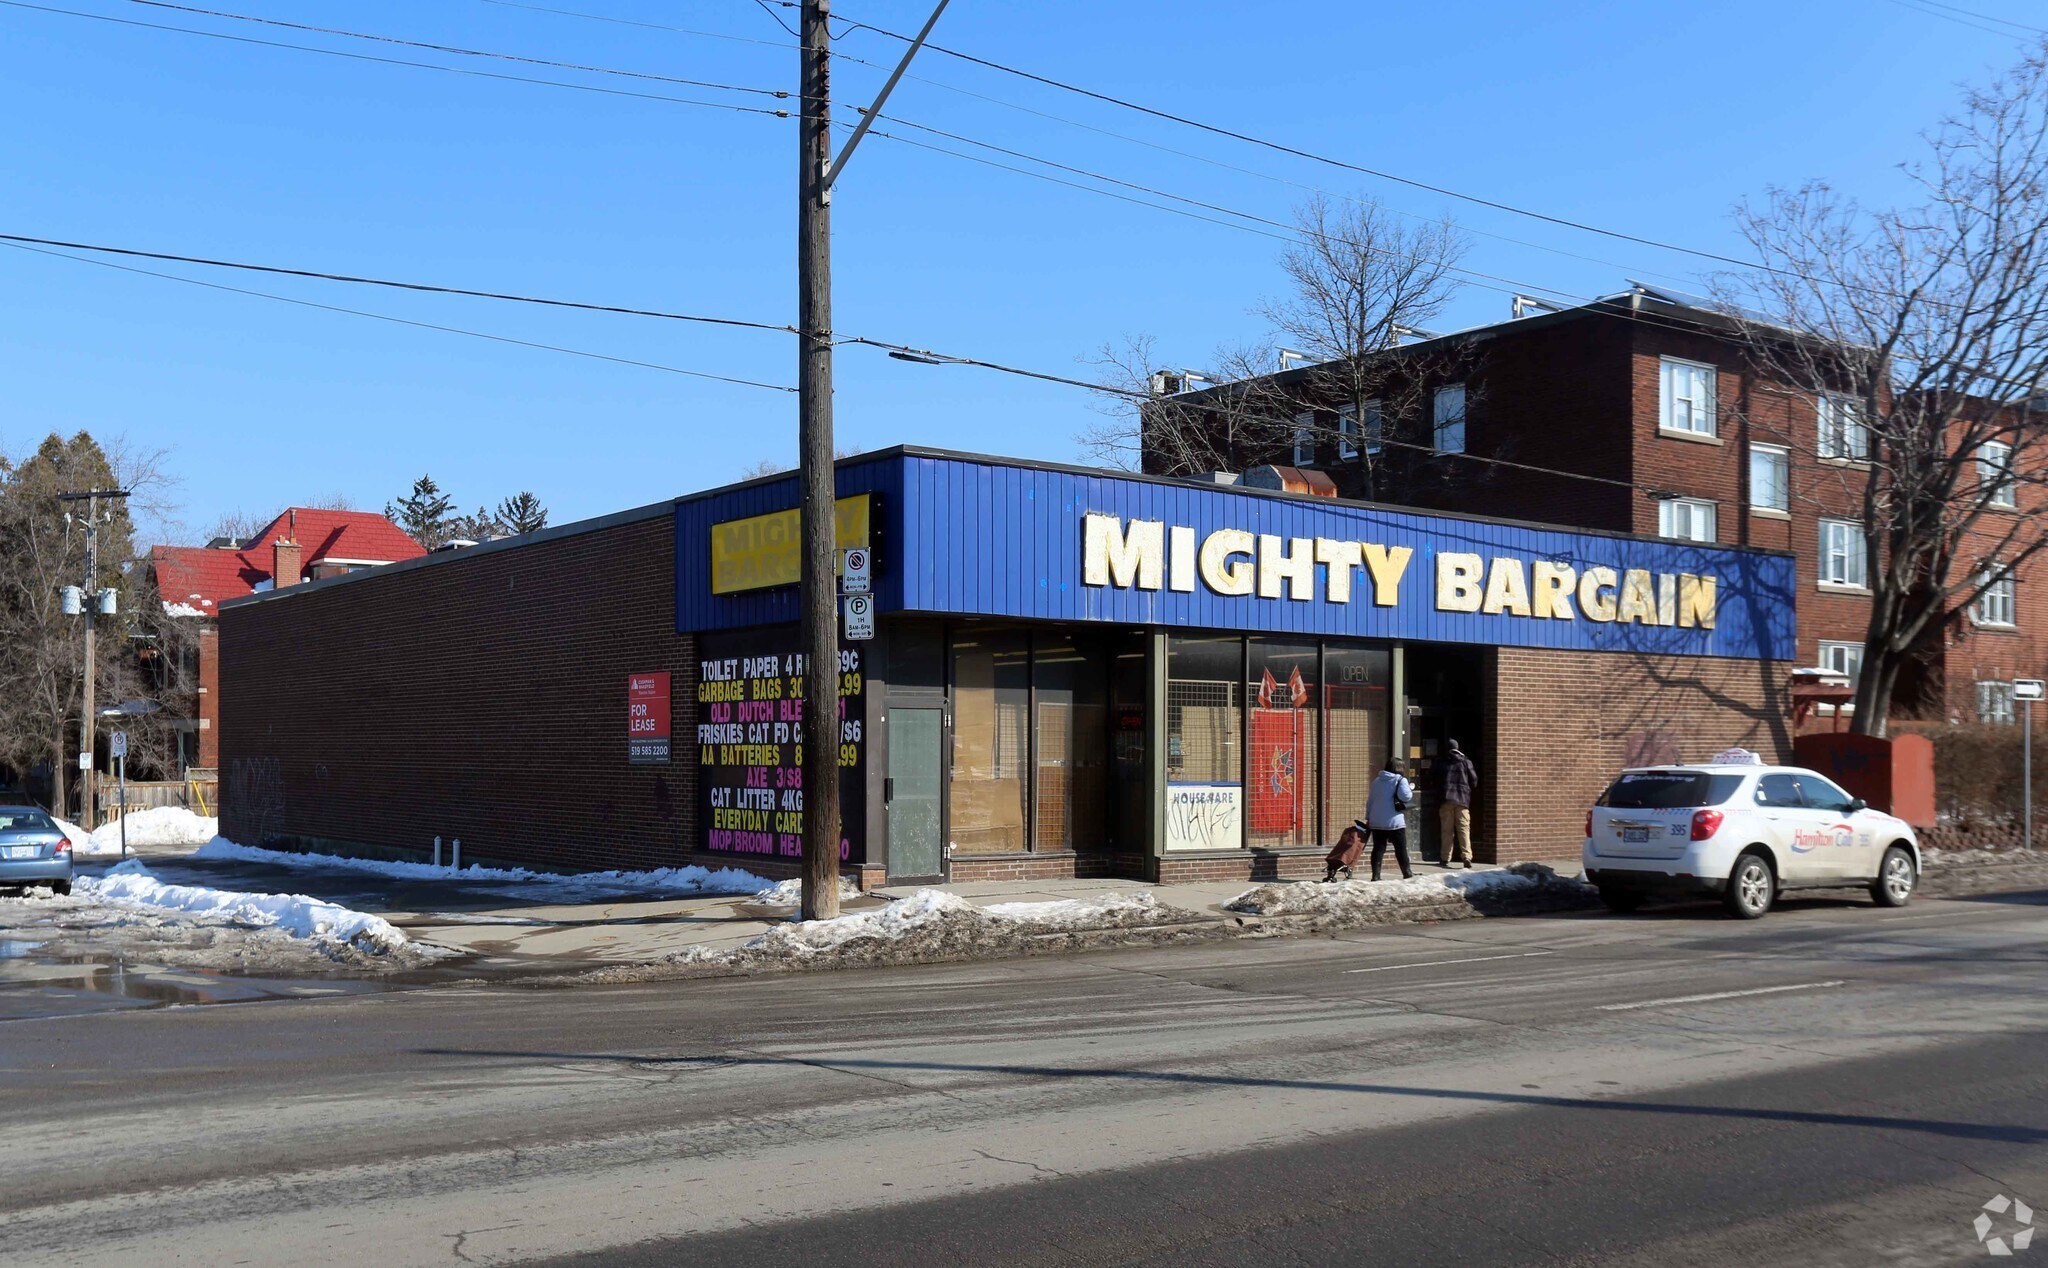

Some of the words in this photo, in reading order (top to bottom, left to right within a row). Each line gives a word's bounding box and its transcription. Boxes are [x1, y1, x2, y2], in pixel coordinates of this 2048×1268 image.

[723, 502, 860, 554] MIGHY
[1083, 513, 1414, 607] MIGHTY
[1435, 551, 1717, 630] BARGAIN
[701, 659, 738, 681] TOILET
[743, 656, 779, 679] PAPER
[785, 654, 793, 676] 4
[1343, 665, 1369, 681] OPEN
[698, 680, 744, 702] GARBAGE
[753, 677, 782, 699] BAGS
[631, 704, 647, 716] FOR
[711, 702, 731, 723] OLD
[738, 700, 774, 723] DUTCH
[780, 699, 802, 721] BLE
[631, 718, 656, 732] LEASE
[698, 723, 744, 744] FRISKIES
[749, 723, 769, 744] CAT
[774, 722, 789, 744] FD
[631, 746, 641, 756] 519
[641, 746, 652, 756] 585
[652, 745, 668, 756] 2200
[701, 745, 715, 765] AA
[721, 744, 780, 766] BATTERIES
[747, 767, 768, 787] AXE
[776, 767, 802, 789] 3/$8
[711, 787, 731, 808] CAT
[737, 788, 776, 810] LITTER
[781, 789, 803, 811] 4KG
[714, 808, 769, 831] EVERYDAY
[1670, 823, 1688, 836] 395
[709, 829, 773, 854] MOP/BROOM
[780, 833, 802, 857] HEA
